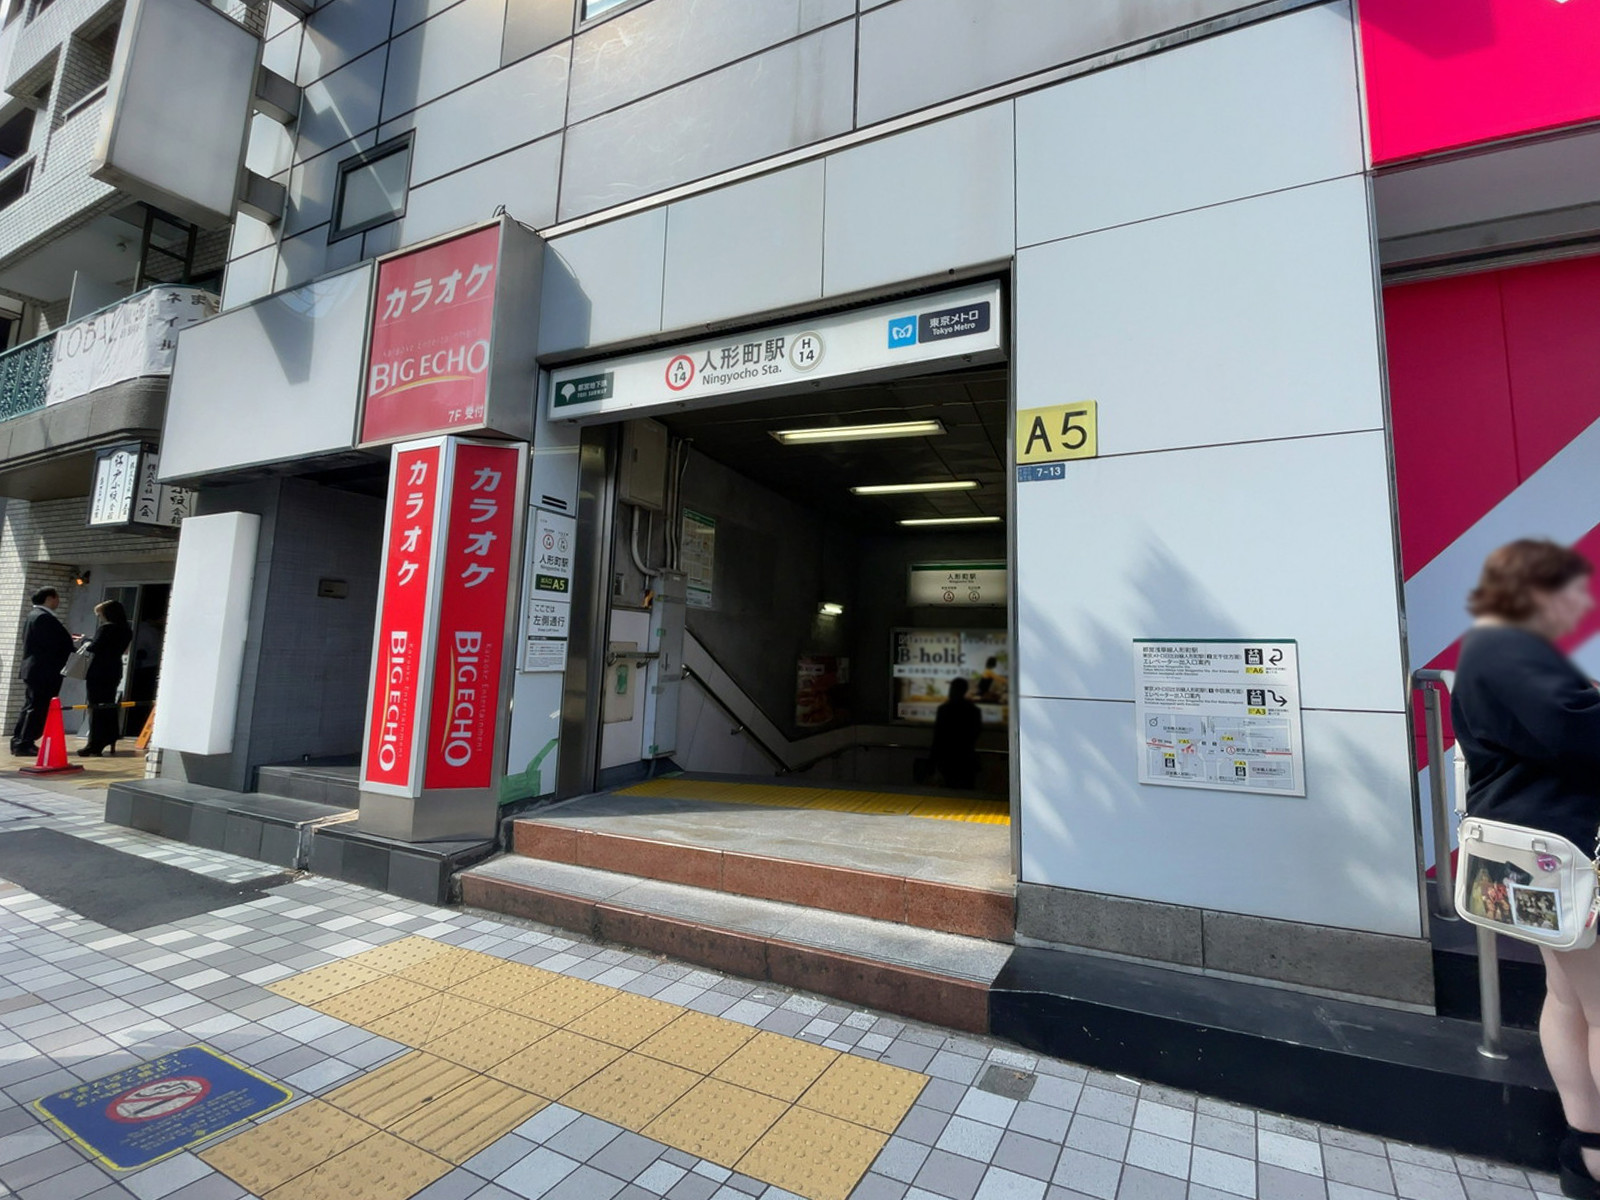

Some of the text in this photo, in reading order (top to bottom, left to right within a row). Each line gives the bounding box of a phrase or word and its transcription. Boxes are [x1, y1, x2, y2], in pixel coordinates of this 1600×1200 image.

[382, 263, 493, 321] カラオケ
[929, 310, 979, 329] 東京メトロ
[932, 322, 976, 336] Tokyo Metro
[802, 338, 811, 350] H
[699, 337, 786, 374] 人形町駅
[799, 350, 815, 363] 14
[368, 339, 490, 397] BIG ECHO
[676, 362, 684, 371] A
[673, 372, 687, 384] 14
[702, 364, 782, 386] Ningyocho Sta.
[448, 408, 462, 423] 7F
[1024, 410, 1088, 455] A5
[1036, 467, 1061, 477] 7-13
[397, 459, 428, 587] カラオケ
[461, 466, 502, 588] カラオケ
[539, 553, 569, 568] 人形町駅
[552, 579, 565, 590] A5
[533, 614, 565, 628] 左側通行
[899, 648, 967, 664] B-holic
[379, 631, 408, 772] BIG ECHO
[444, 631, 482, 767] BIG ECHO
